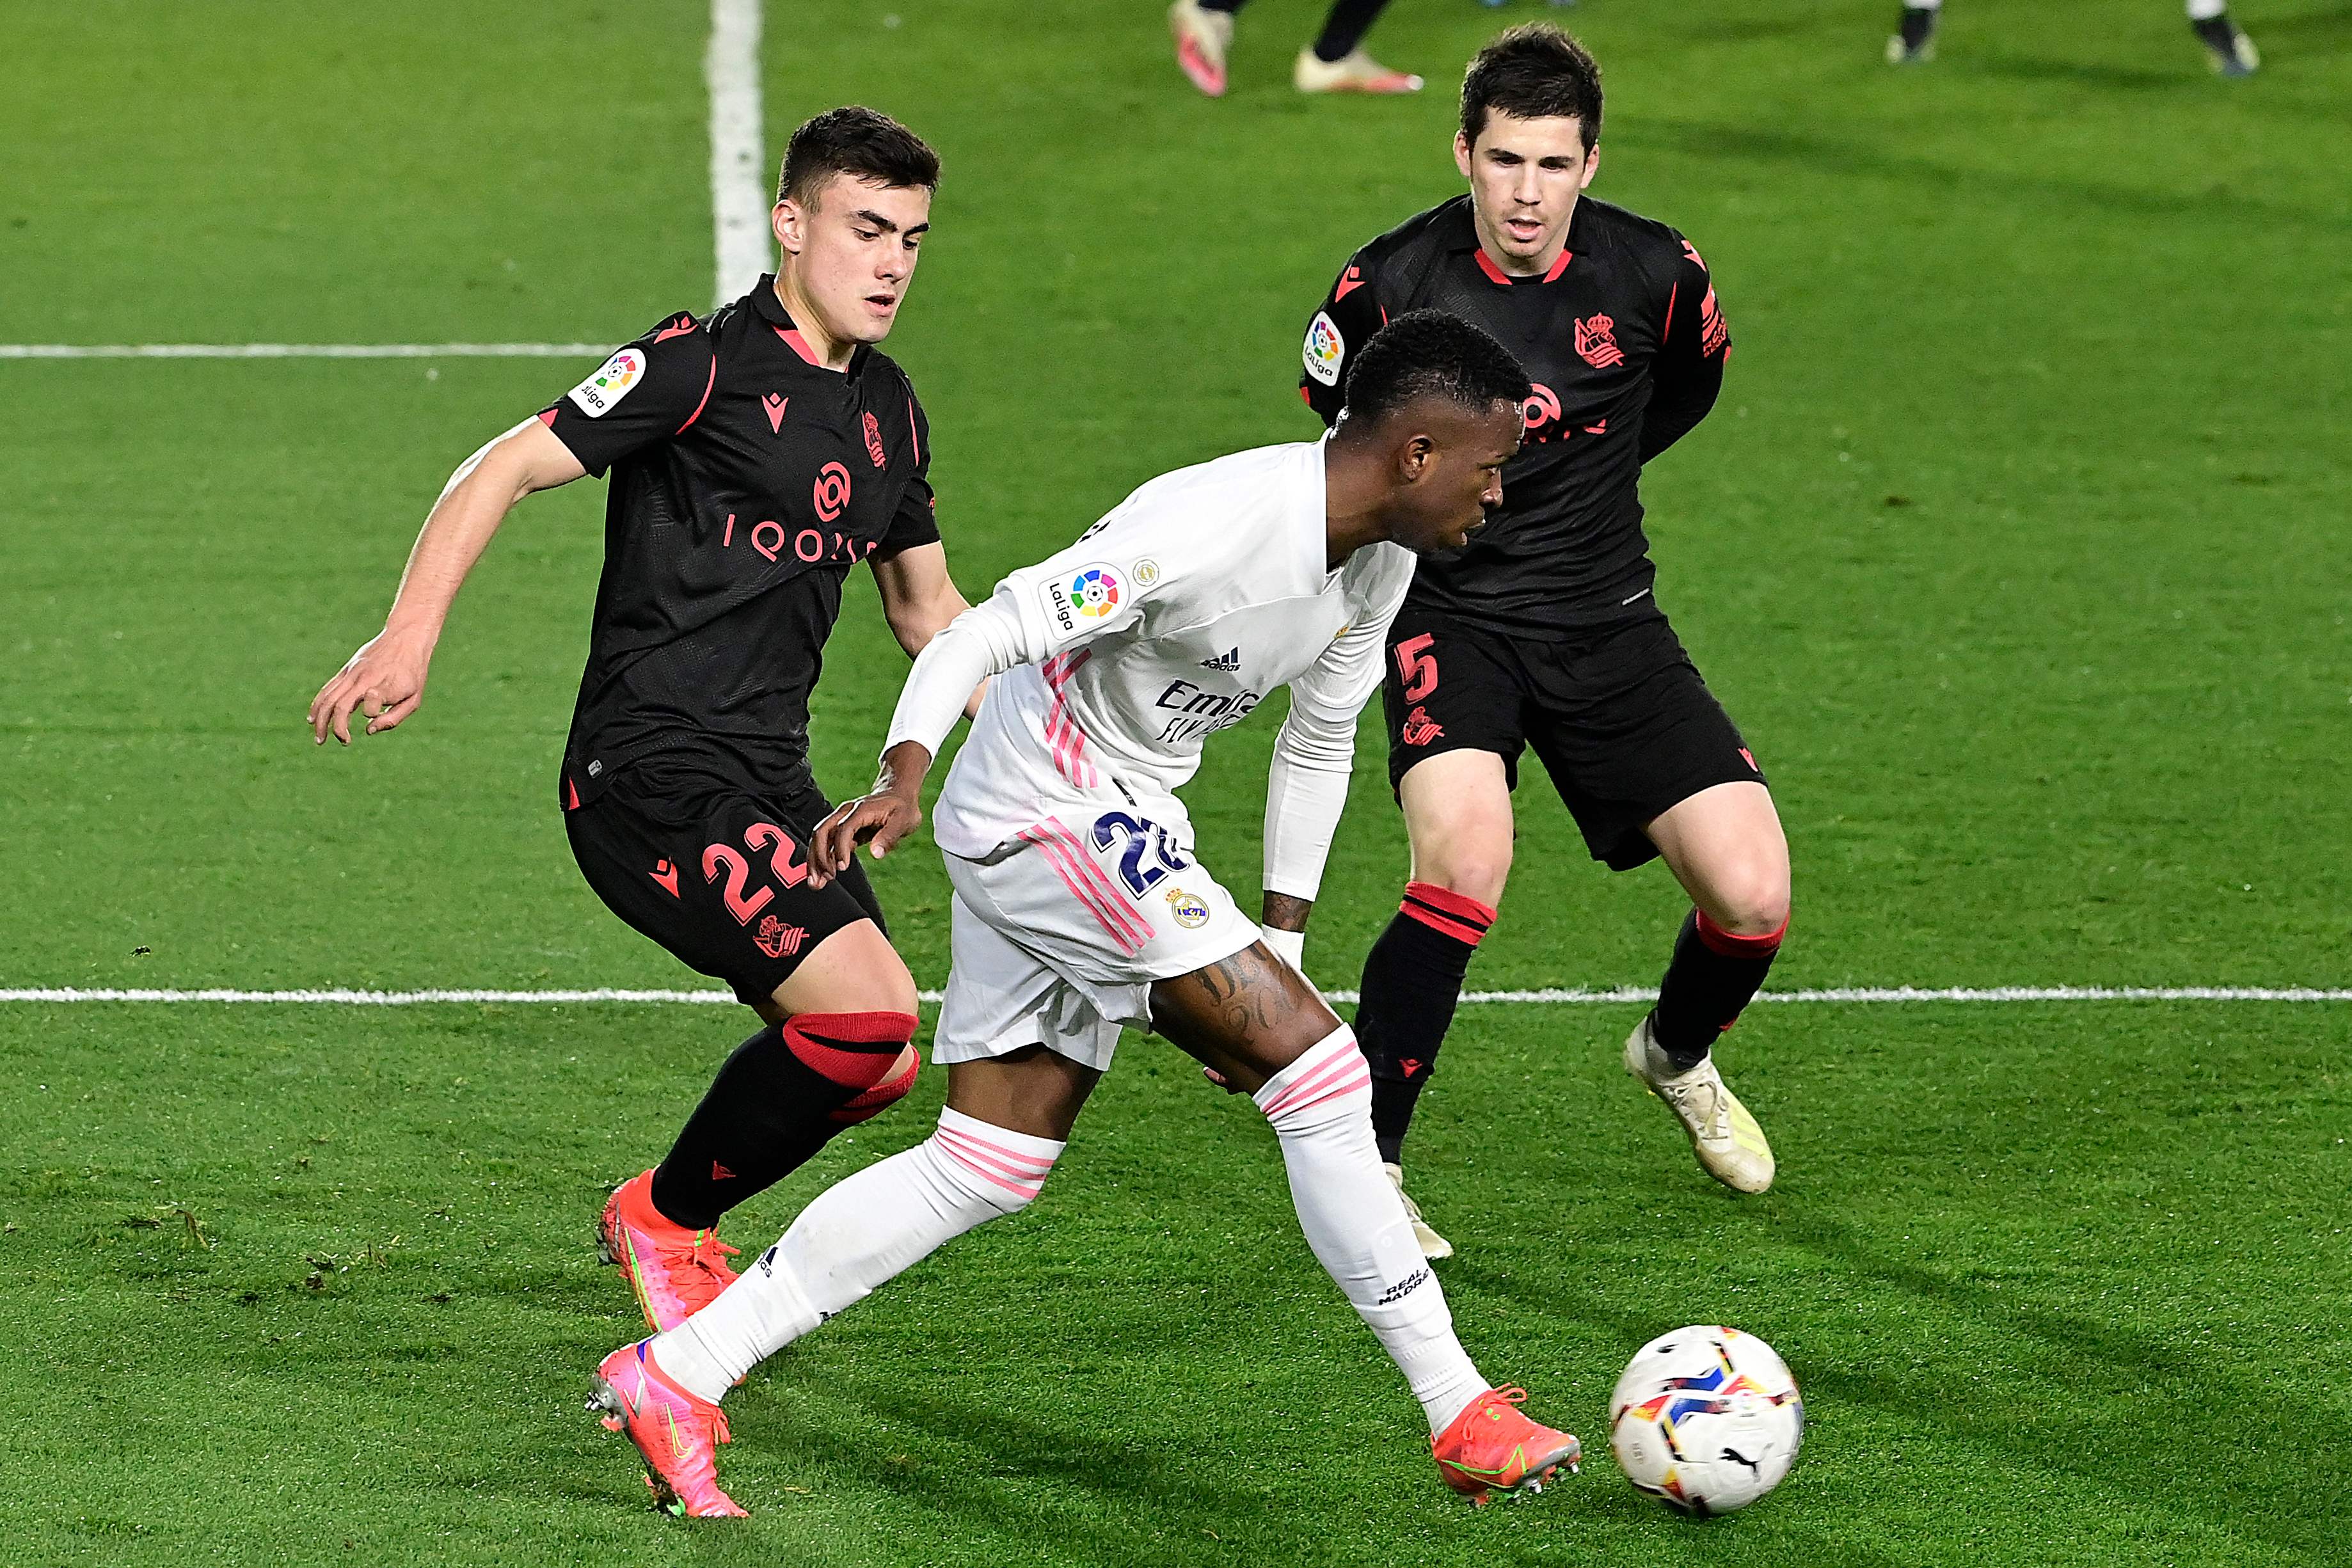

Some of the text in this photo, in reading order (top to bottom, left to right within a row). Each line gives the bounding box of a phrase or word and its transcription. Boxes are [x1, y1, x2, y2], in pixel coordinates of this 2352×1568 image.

[1305, 346, 1333, 377] LaLiga
[1049, 583, 1074, 631] LaLiga
[1200, 658, 1241, 672] adidas
[1394, 632, 1438, 705] 5
[701, 822, 807, 927] 22
[1387, 1269, 1422, 1295] REAL
